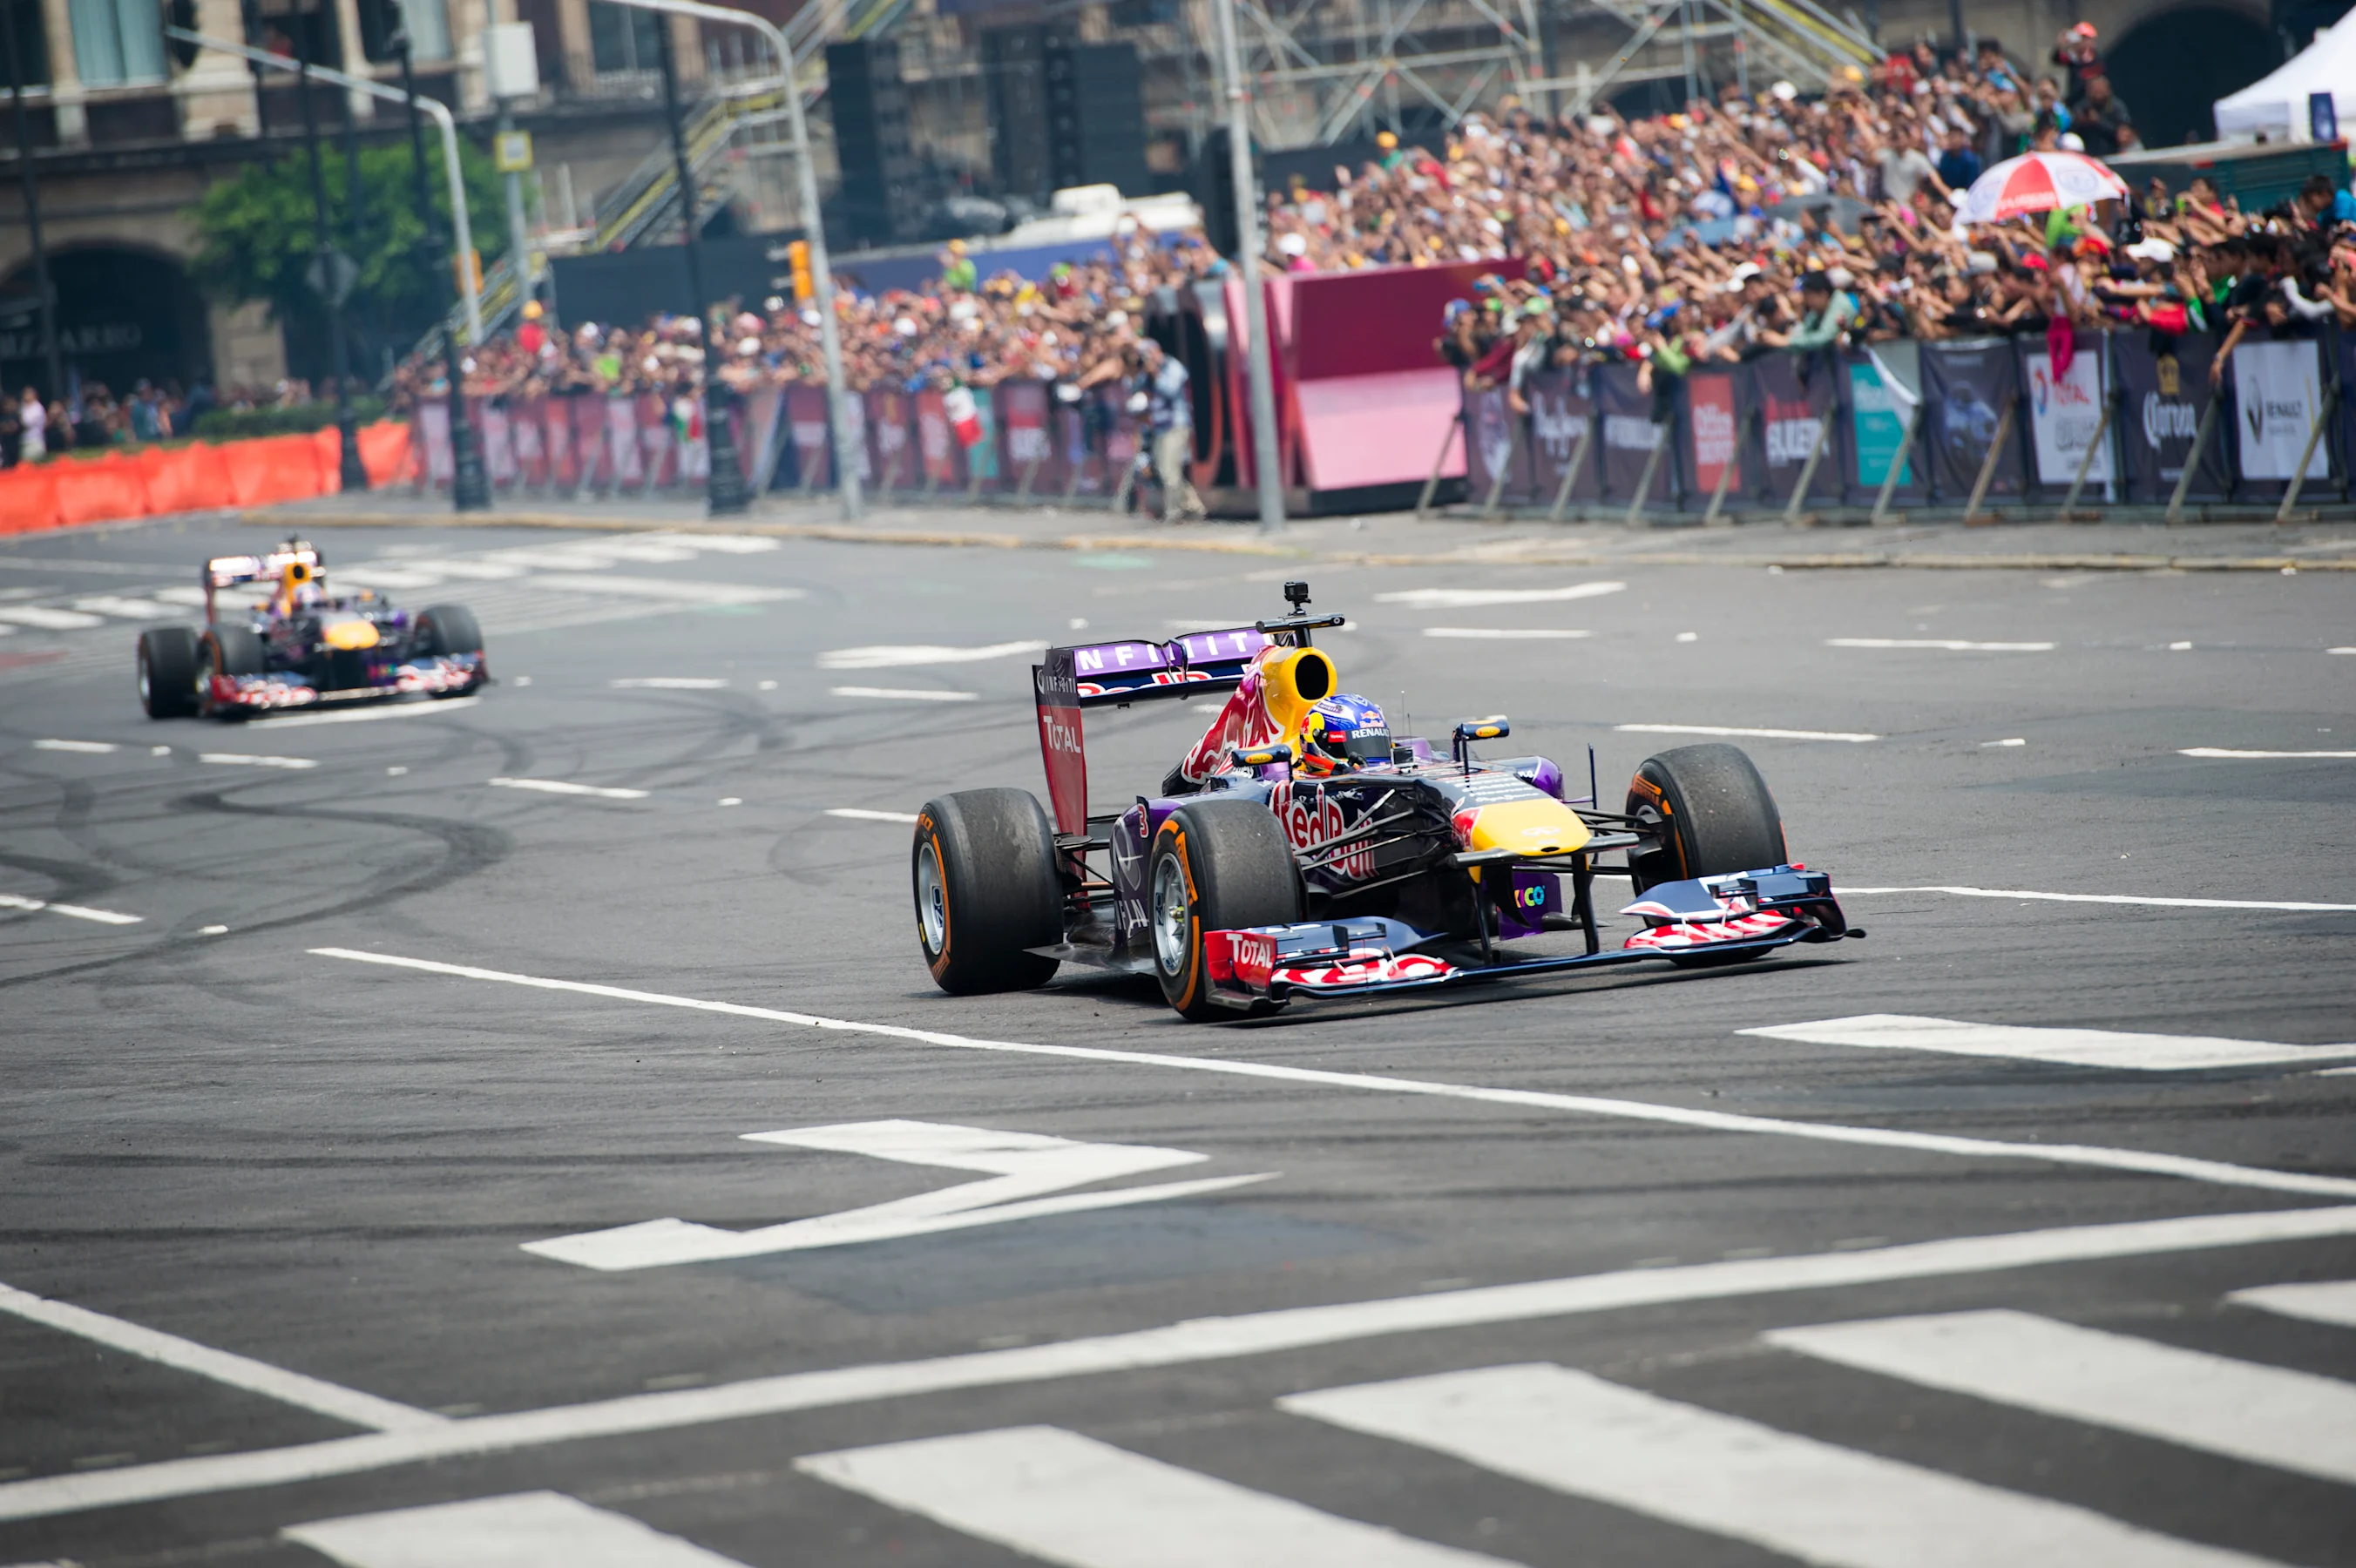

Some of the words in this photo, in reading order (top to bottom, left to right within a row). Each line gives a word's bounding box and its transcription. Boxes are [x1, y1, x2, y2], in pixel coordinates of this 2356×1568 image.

[1043, 715, 1081, 754] TOTAL
[1137, 803, 1149, 839] 3
[1225, 932, 1273, 969] TOTAL
